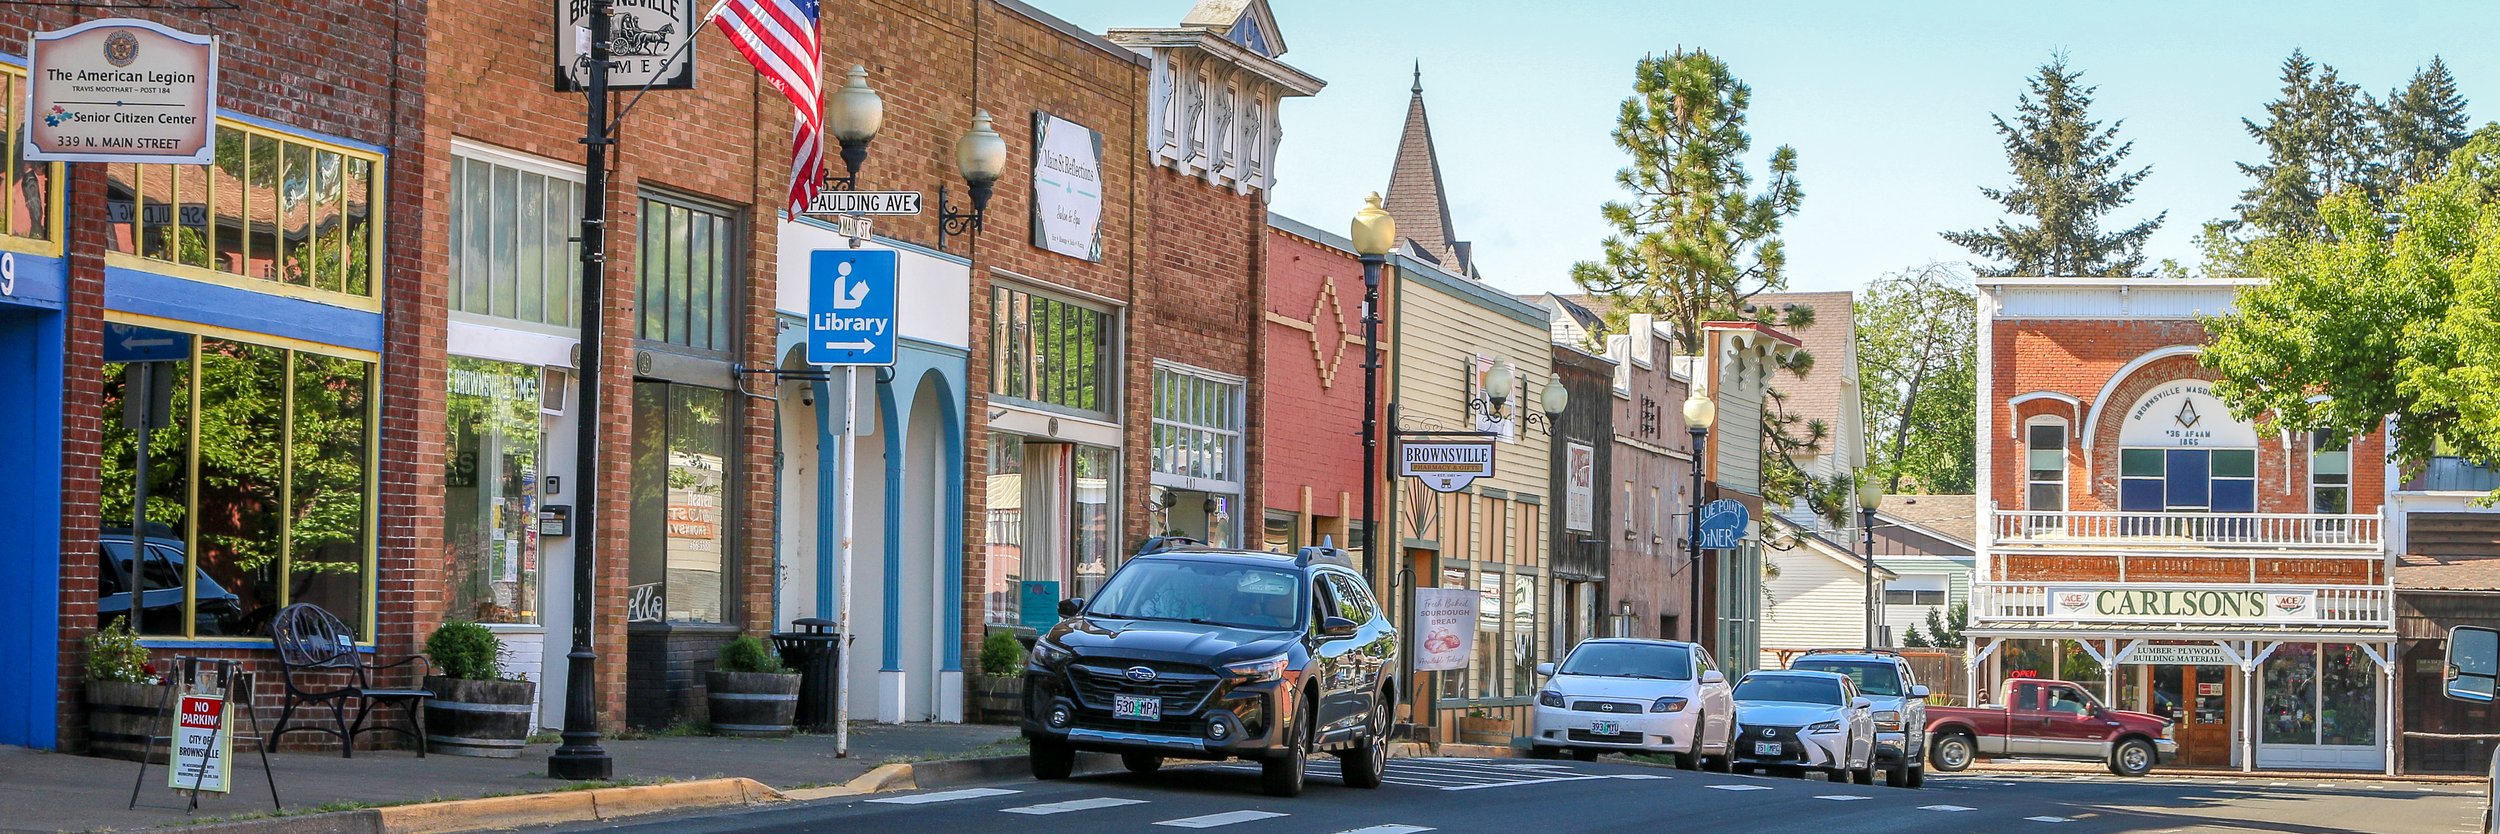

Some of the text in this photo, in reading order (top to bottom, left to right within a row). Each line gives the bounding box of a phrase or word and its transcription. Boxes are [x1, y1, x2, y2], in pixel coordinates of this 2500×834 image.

[47, 69, 195, 85] The American Legion
[74, 112, 197, 125] Senior Citizen Center
[57, 136, 181, 149] 339 N. MAIN STREET
[1044, 149, 1093, 182] Main St Reflections
[886, 195, 912, 211] AVE
[842, 217, 868, 238] MAIN ST
[814, 313, 888, 336] Library
[2134, 386, 2181, 421] BROWNSVILLE
[1406, 447, 1488, 462] BROWNSVILLE
[688, 490, 712, 507] Heaven
[1695, 500, 1741, 524] LUE POINT
[1424, 598, 1469, 608] Fresh Baked
[2064, 594, 2082, 602] ACE
[2096, 590, 2264, 617] CARLSON'S
[2280, 596, 2298, 604] ACE
[2012, 670, 2037, 678] OPEN
[194, 702, 209, 712] NO
[1116, 700, 1158, 715] 530 MPA
[1592, 722, 1604, 731] 393
[189, 735, 202, 744] CITY
[179, 746, 219, 759] BROWNSLLE
